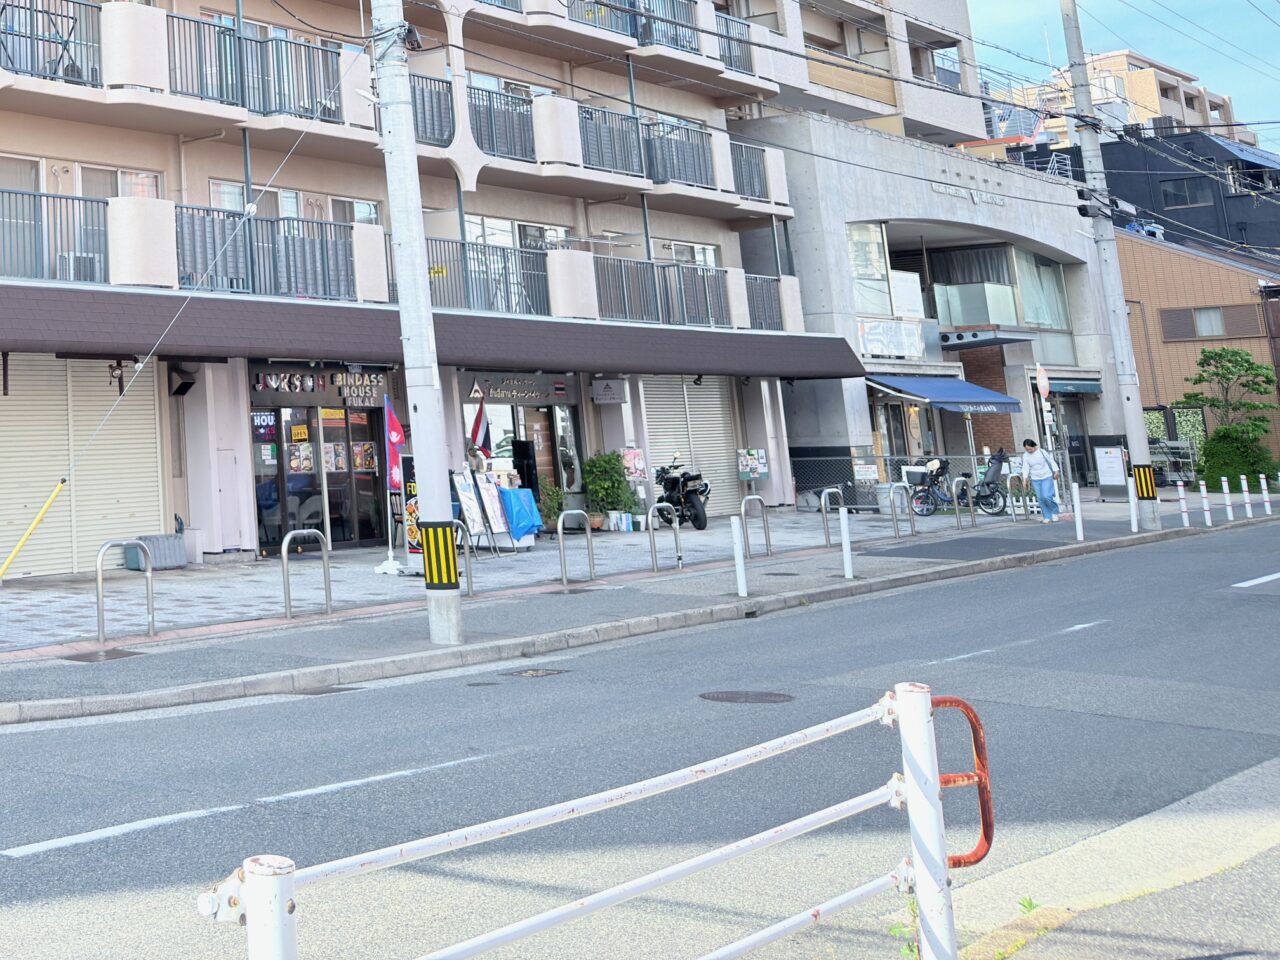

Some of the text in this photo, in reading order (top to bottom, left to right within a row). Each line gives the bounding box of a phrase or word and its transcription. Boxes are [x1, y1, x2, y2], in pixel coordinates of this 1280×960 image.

[334, 372, 385, 386] BINDASS
[343, 386, 378, 397] HOUSE
[346, 397, 376, 407] FUKAE
[254, 415, 276, 426] HOU
[292, 430, 307, 438] OPEN
